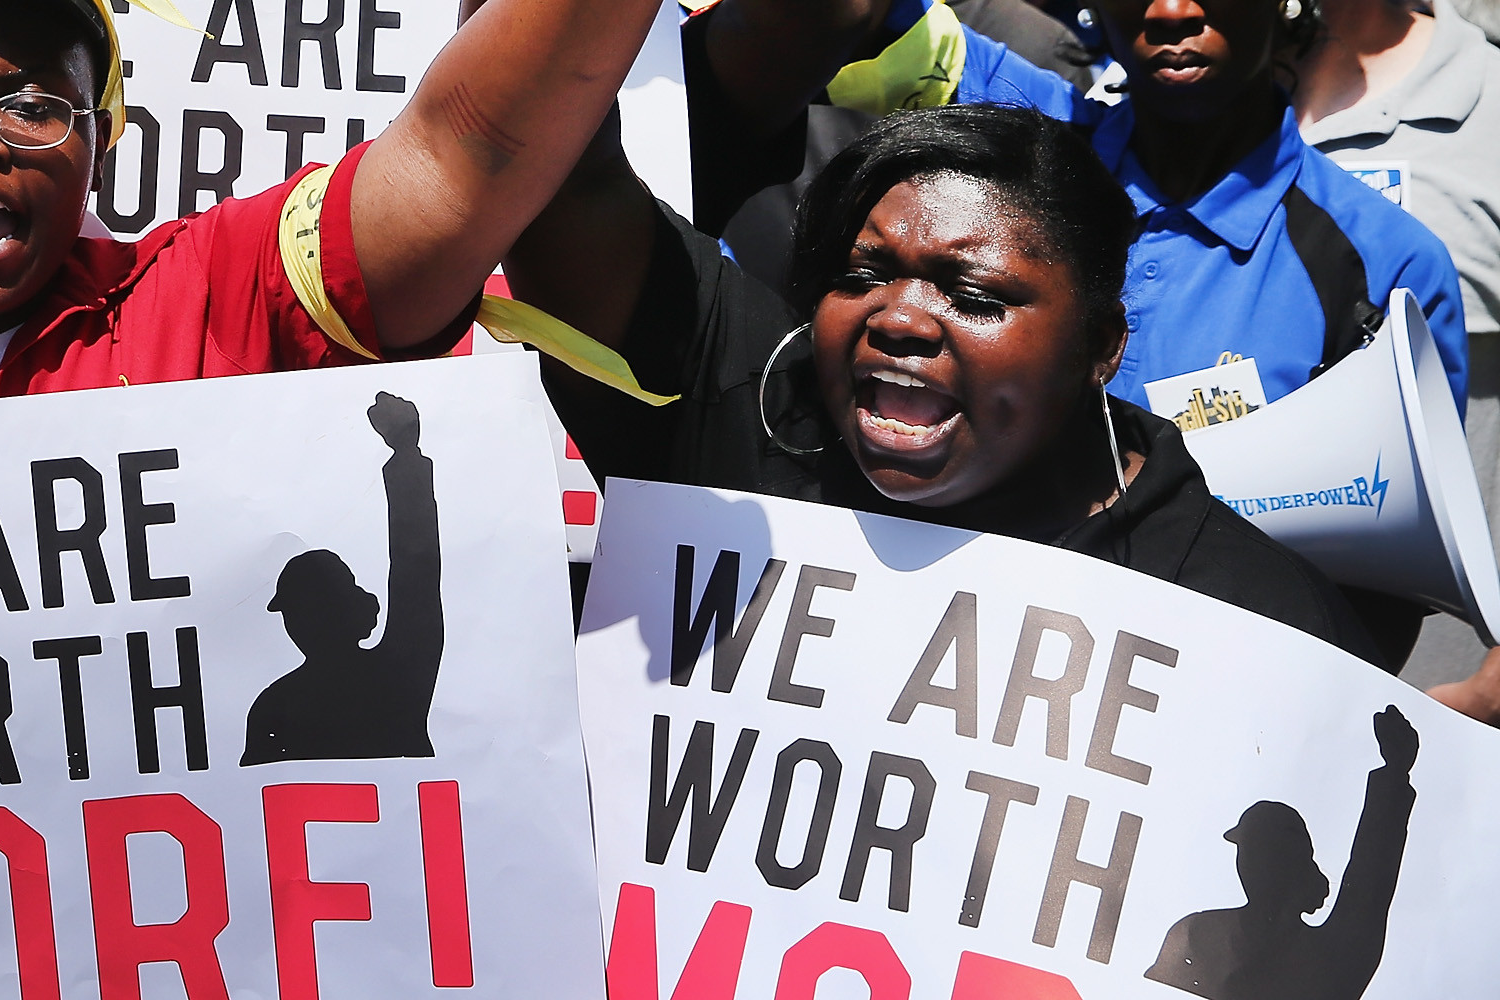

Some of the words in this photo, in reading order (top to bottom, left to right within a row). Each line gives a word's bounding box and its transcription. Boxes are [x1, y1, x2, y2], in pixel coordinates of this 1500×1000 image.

[670, 543, 857, 707] WE
[887, 590, 1180, 785] ARE
[645, 714, 1143, 965] WORTH
